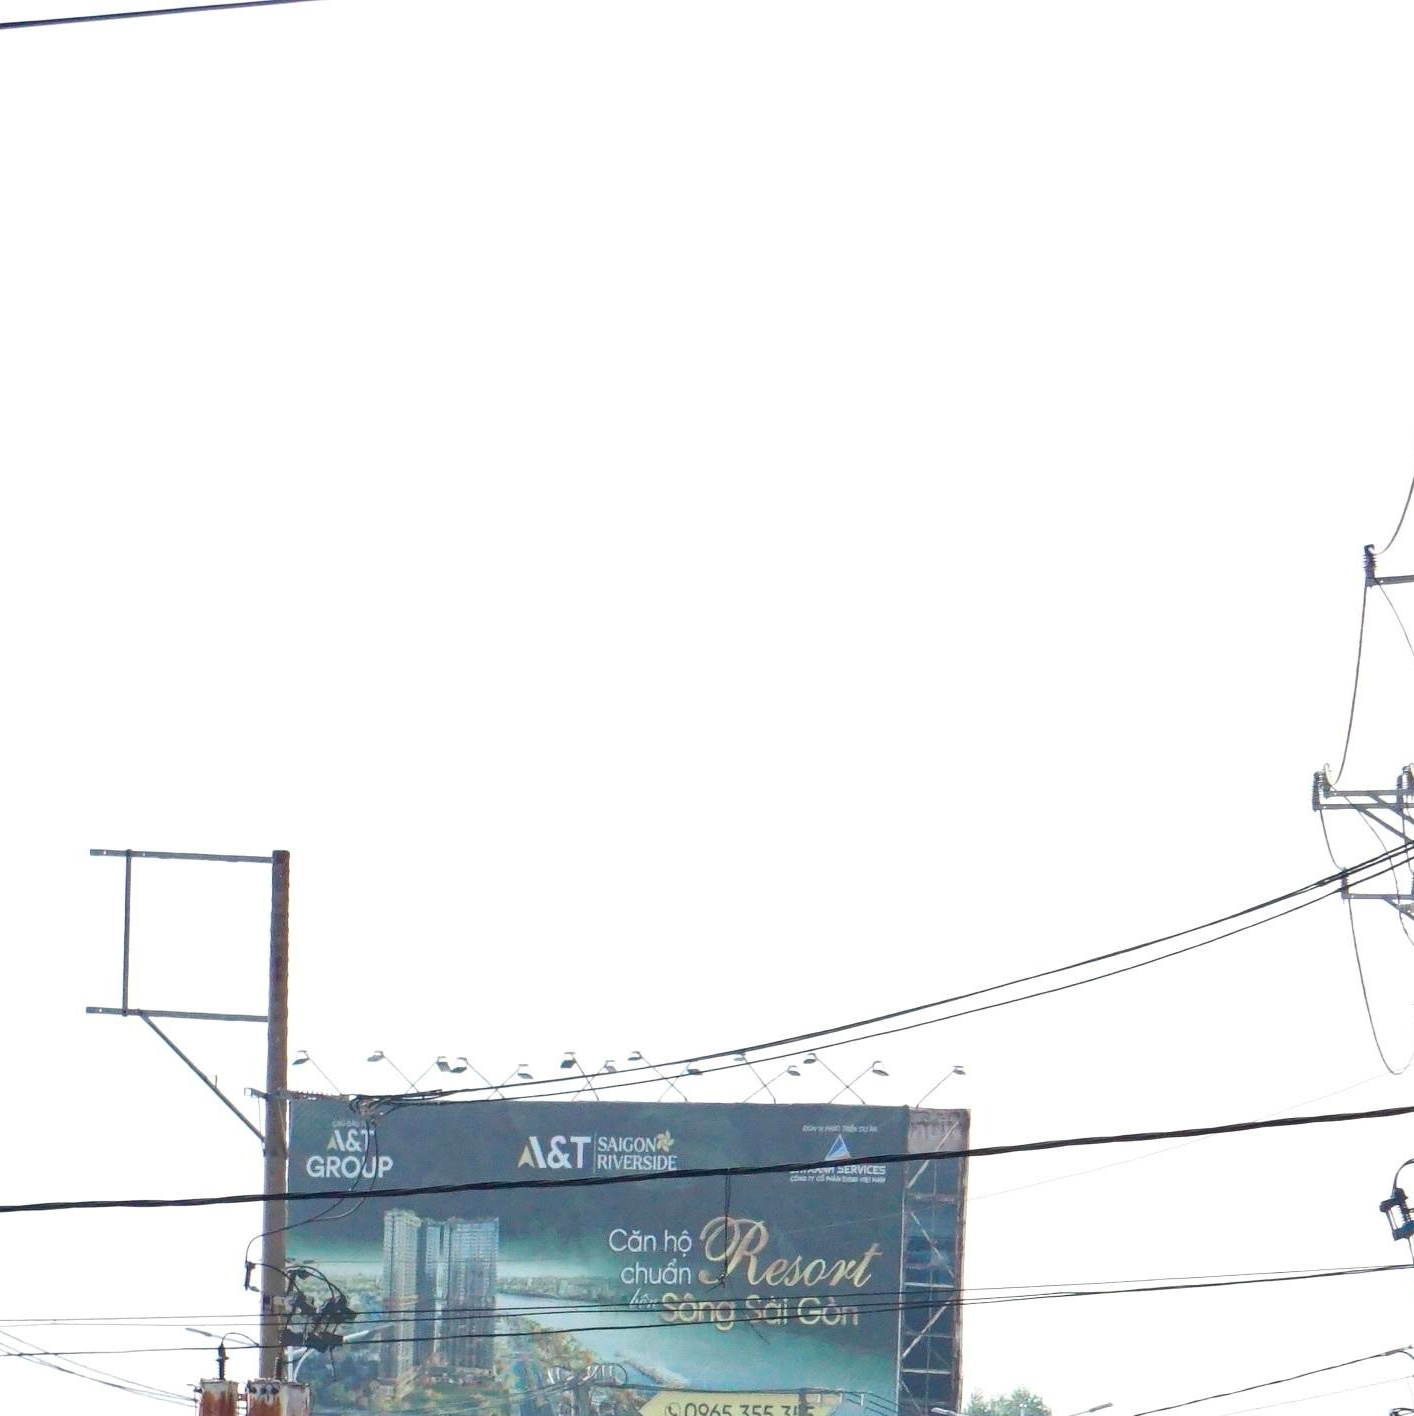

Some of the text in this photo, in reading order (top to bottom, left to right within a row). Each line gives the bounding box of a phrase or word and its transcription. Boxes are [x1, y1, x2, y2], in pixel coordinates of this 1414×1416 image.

[517, 1135, 590, 1170] A&T
[597, 1136, 658, 1153] SAIGON
[306, 1155, 393, 1179] GROUP
[597, 1154, 678, 1172] RIVERSIDE
[837, 1164, 887, 1175] SERVICES
[609, 1229, 691, 1258] Căn hộ
[698, 1216, 883, 1288] Resort
[621, 1259, 691, 1285] chuẩn
[659, 1291, 737, 1331] Sông
[745, 1294, 788, 1326] Sài
[798, 1296, 859, 1326] Gòn
